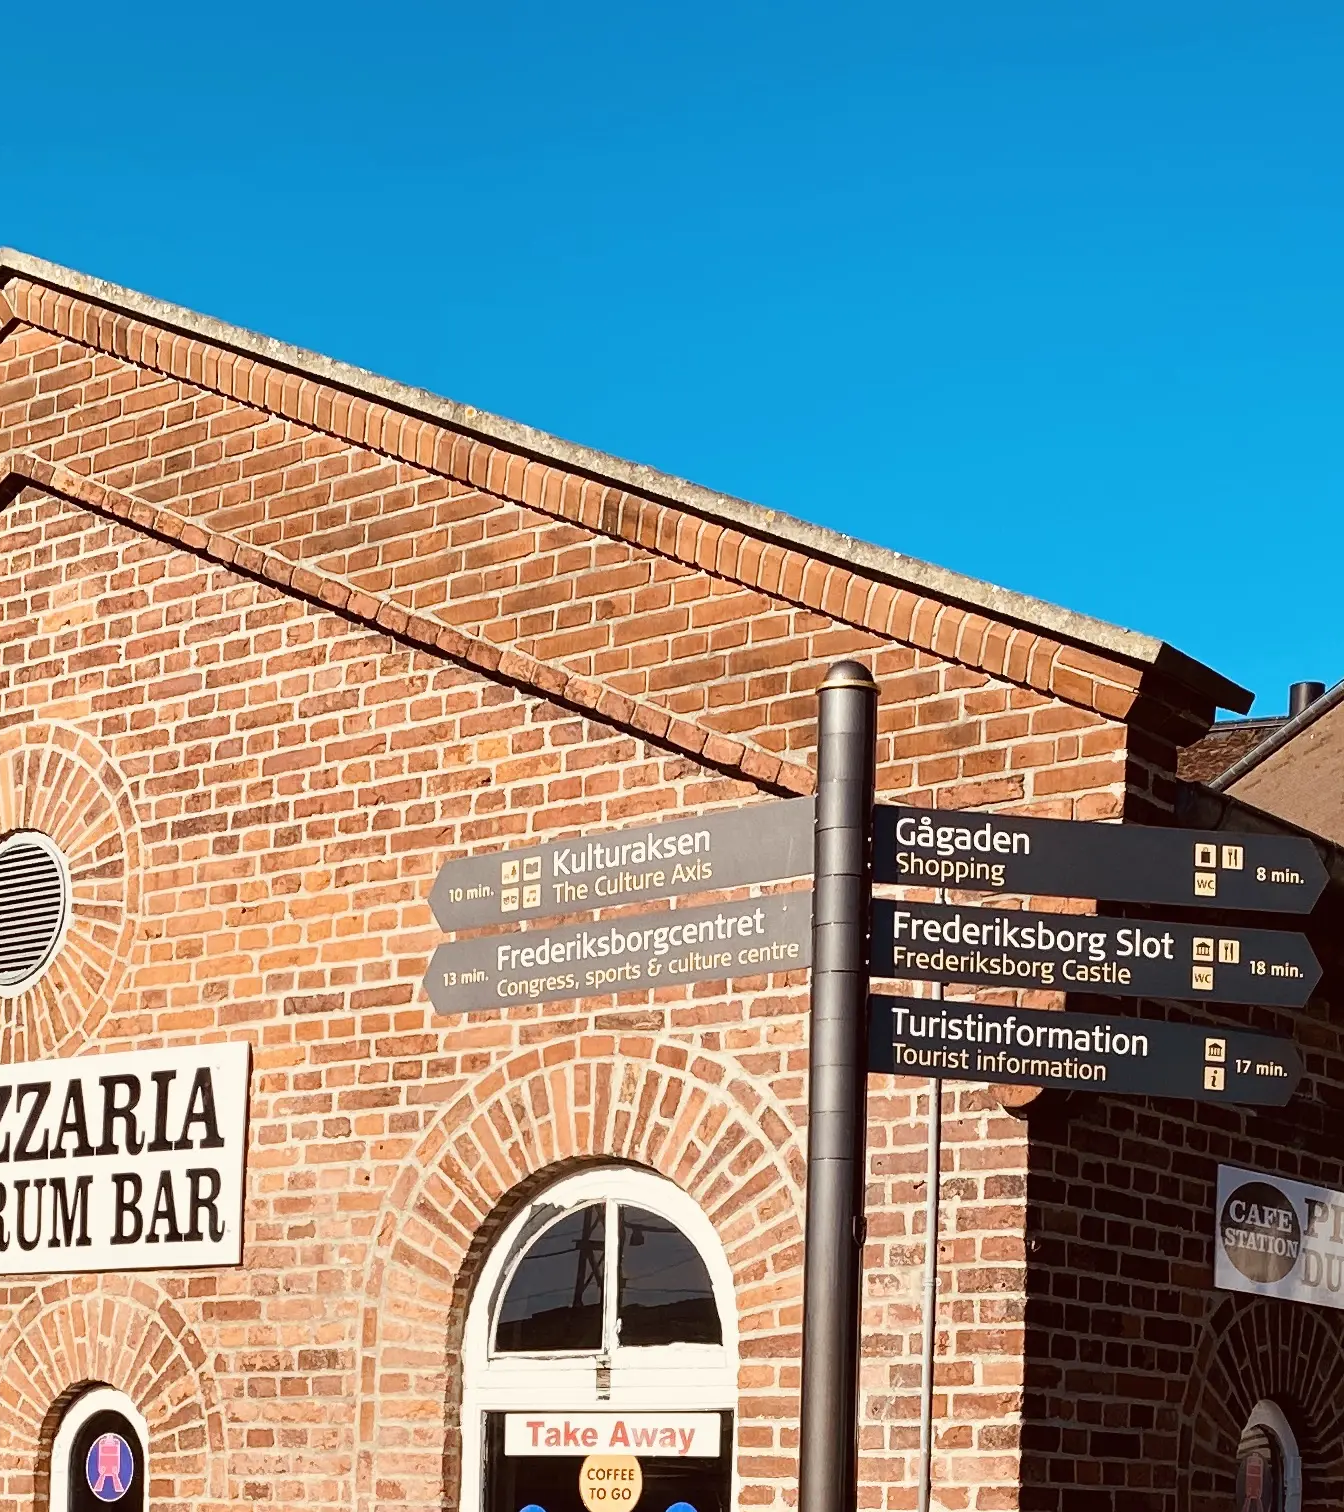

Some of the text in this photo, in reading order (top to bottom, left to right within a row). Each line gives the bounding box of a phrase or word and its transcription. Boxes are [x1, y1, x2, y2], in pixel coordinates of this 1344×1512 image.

[896, 816, 1030, 856] Gågaden
[552, 830, 711, 877] Kulturaksen
[896, 852, 1005, 886] Shopping
[553, 859, 713, 903] The Culture Axis
[1197, 880, 1215, 890] WC
[1256, 867, 1305, 884] 8 min.
[448, 884, 495, 902] 10 min.
[496, 907, 765, 971] Frederiksborgcentret
[893, 911, 1175, 961] Frederiksborg Slot
[443, 968, 489, 986] 13 min.
[497, 941, 800, 999] Congress, sports & culture centre
[893, 946, 1132, 985] Frederiksborg Castle
[1194, 974, 1212, 984] WC
[1250, 960, 1304, 978] 18 min.
[891, 1007, 1148, 1057] Turistinformation
[892, 1043, 1107, 1082] Tourist information
[1236, 1059, 1288, 1077] 17 min.
[110, 1167, 226, 1246] BAR
[1229, 1199, 1293, 1233] CAFE
[1224, 1227, 1298, 1259] STATION
[526, 1421, 696, 1454] Take Away
[587, 1468, 635, 1481] COFFEE
[589, 1487, 632, 1500] TO GO
